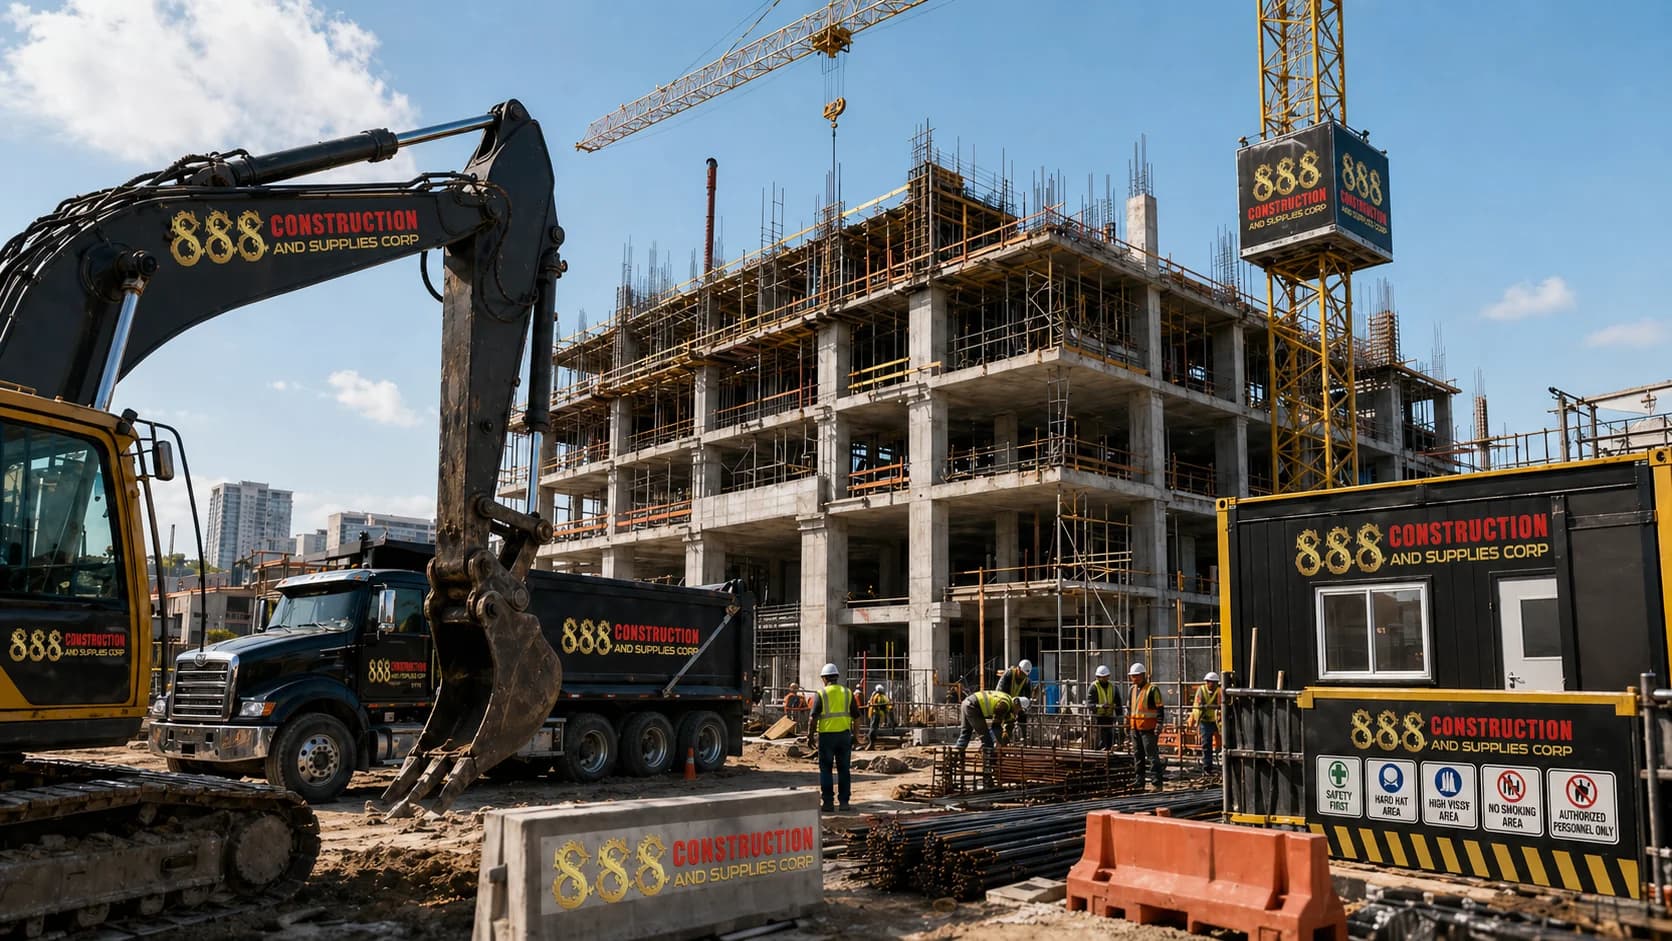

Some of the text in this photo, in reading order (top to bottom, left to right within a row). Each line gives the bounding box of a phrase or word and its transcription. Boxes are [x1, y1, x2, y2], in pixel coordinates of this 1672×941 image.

[1253, 150, 1322, 202] 888
[1342, 152, 1382, 206] 888
[1248, 187, 1327, 220] CONSTRUCTION
[270, 210, 418, 237] CONSTRUCTION
[1248, 220, 1265, 231] AND
[170, 209, 269, 267] 888
[273, 234, 419, 255] AND SUPPLIES CORP
[1389, 513, 1548, 548] CONSTRUCTION
[1295, 522, 1387, 577] 888
[1390, 543, 1549, 566] AND SUPPLIES CORP
[8, 628, 63, 662] 888
[561, 617, 612, 656] 888
[615, 623, 699, 645] CONSTRUCTION
[64, 648, 78, 656] AND
[614, 644, 699, 656] AND SUPPLIES CORP
[368, 659, 390, 683] 888
[1351, 708, 1427, 753] 888
[1430, 716, 1573, 741] CONSTRUCTION
[1431, 740, 1573, 757] AND SUPPLIES CORP
[1326, 789, 1352, 801] SAFETY
[1375, 795, 1409, 806] HARD HAT
[1429, 799, 1446, 808] HIGH
[1329, 801, 1349, 812] FIRST
[1382, 806, 1401, 817] AREA
[1439, 811, 1459, 822] AREA
[1488, 803, 1536, 817] NO SMOKING
[1559, 809, 1606, 823] AUTHORIZED
[1502, 817, 1523, 829] AREA
[1553, 821, 1614, 837] PERSONNEL ONLY
[672, 826, 813, 867] CONSTRUCTION
[552, 833, 670, 911] 888
[673, 855, 814, 888] AND SUPPLIES CORP
